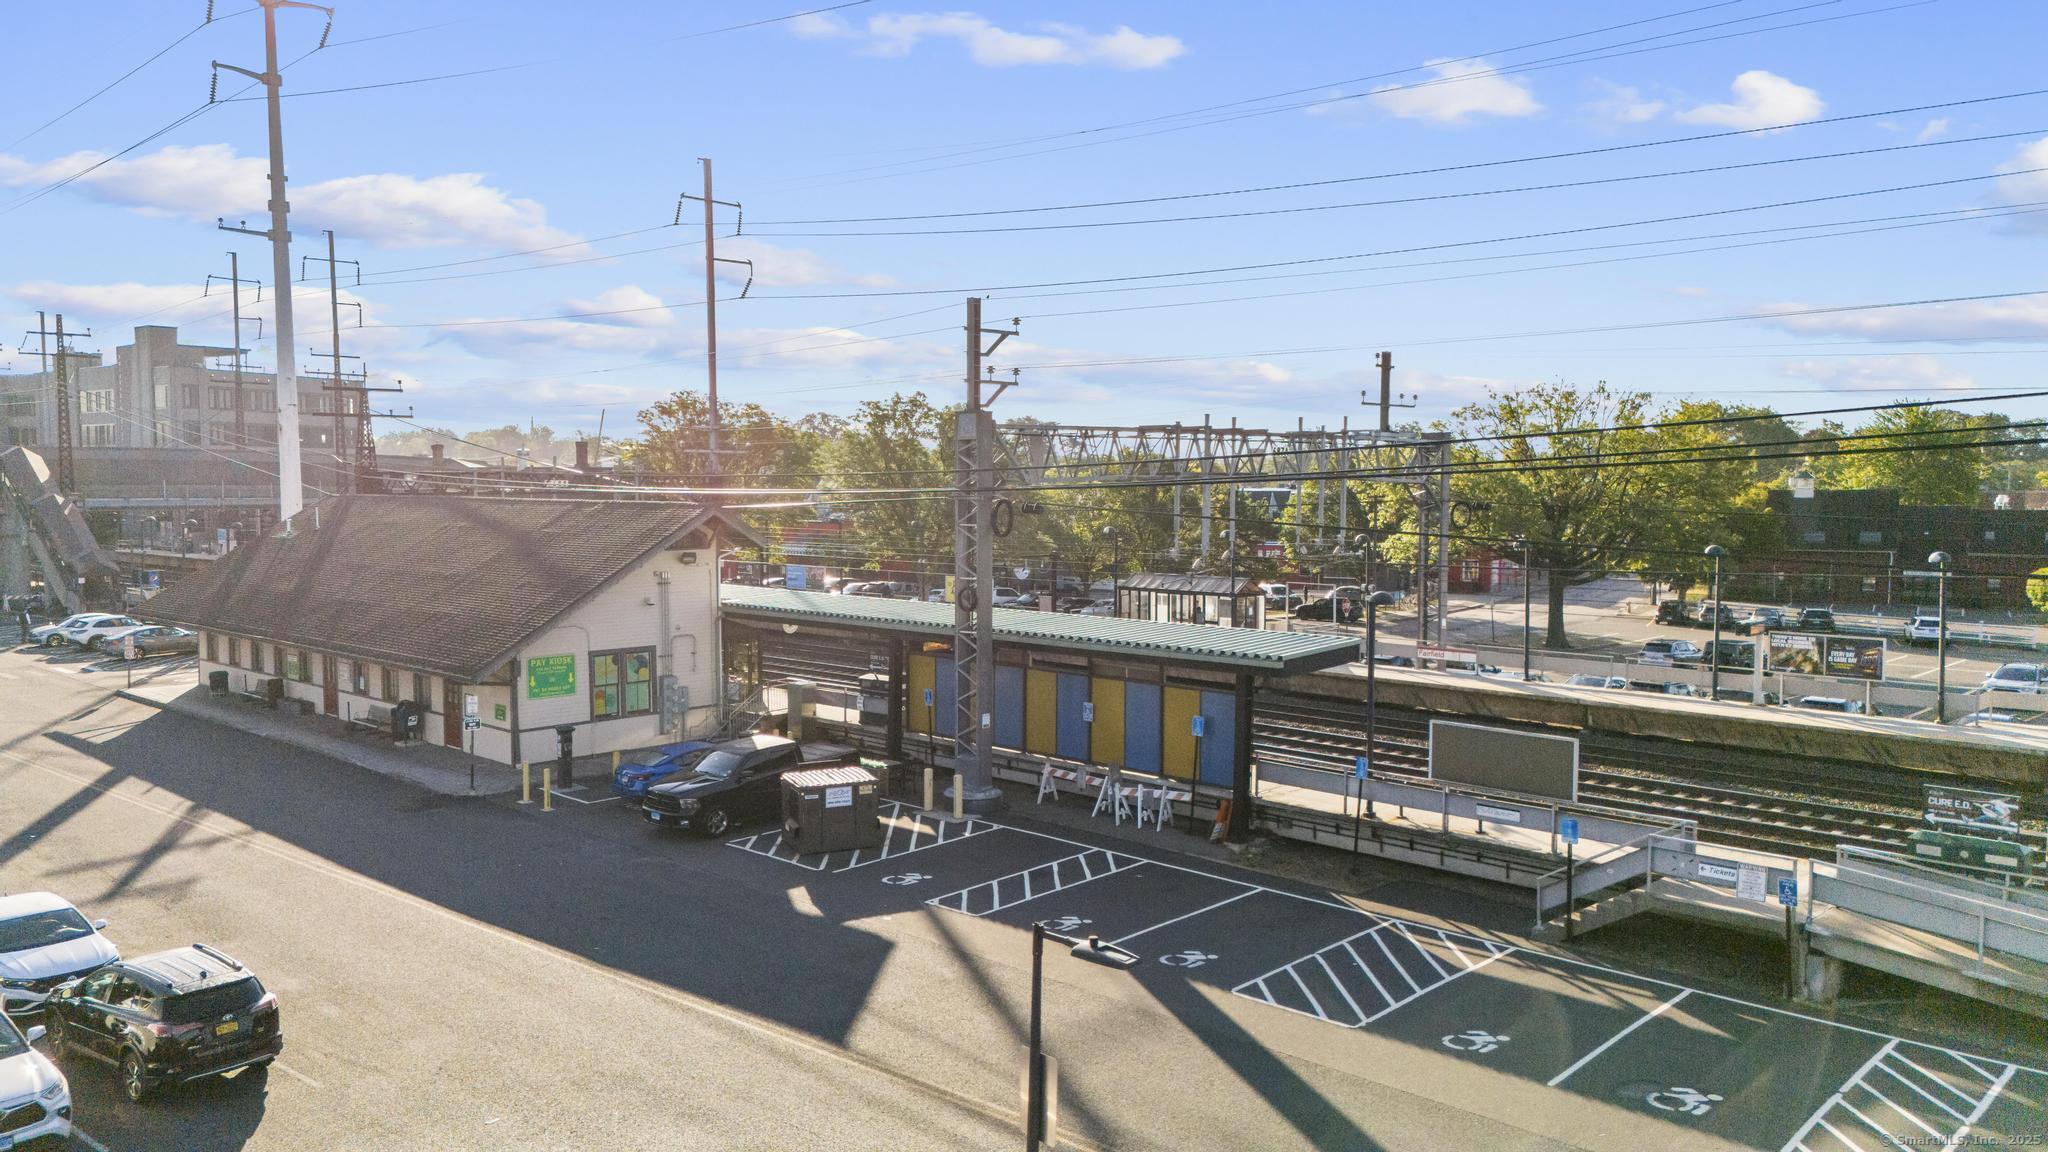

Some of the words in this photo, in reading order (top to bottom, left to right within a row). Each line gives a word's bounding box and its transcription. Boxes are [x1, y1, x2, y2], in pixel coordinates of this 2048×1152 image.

[1418, 648, 1445, 659] Fairfield
[531, 659, 545, 667] PAY
[549, 656, 572, 665] KIOSK
[1928, 795, 1953, 807] CURE
[1954, 800, 1972, 810] E.D.
[1709, 866, 1737, 878] Tickets
[1739, 863, 1767, 873] WARNING
